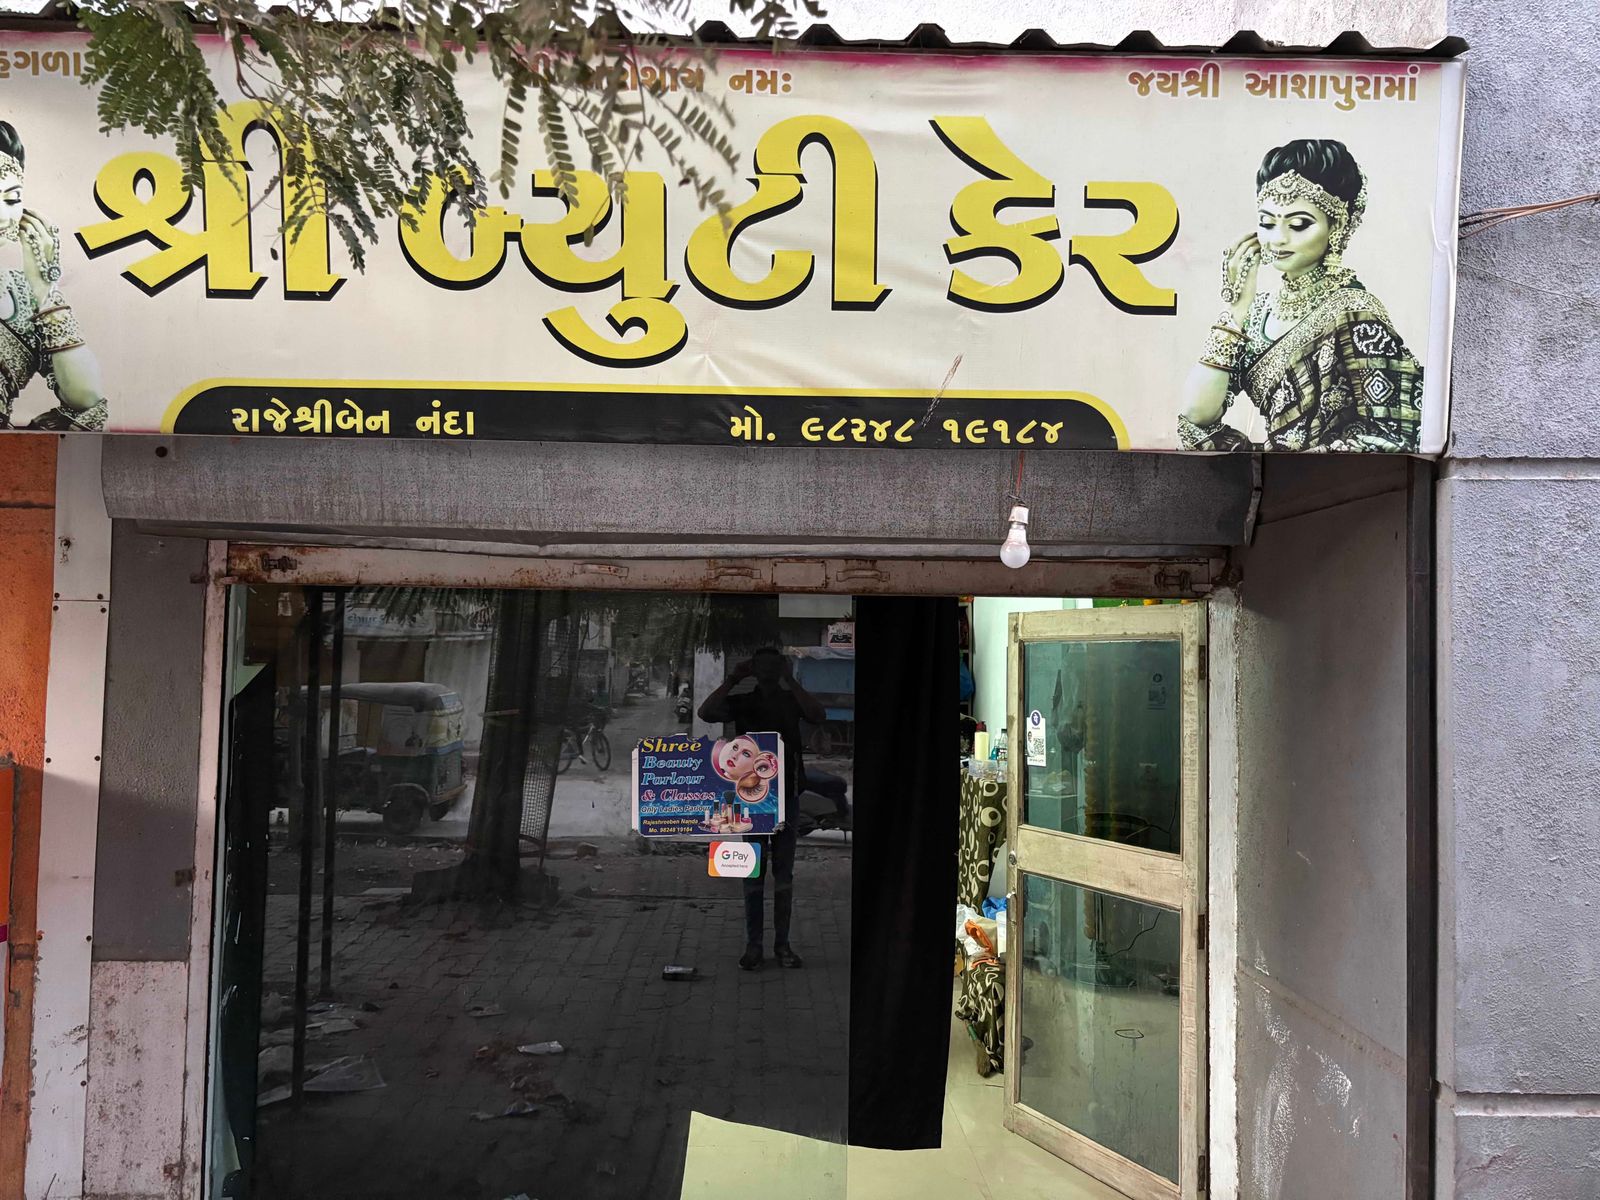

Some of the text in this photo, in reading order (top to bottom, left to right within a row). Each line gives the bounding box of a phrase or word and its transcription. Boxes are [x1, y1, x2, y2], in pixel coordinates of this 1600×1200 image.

[729, 68, 792, 95] નમઃ
[1128, 62, 1419, 111] જયશ્રી આશાપુરામાં
[74, 99, 1180, 369] શ્રી બ્યુટી કેર
[231, 397, 475, 435] રાજેશ્રીબેન નંદા
[730, 405, 1064, 445] મો. ૯૮૨૪૮ ૧૯૧૮૪
[641, 736, 702, 753] Shree
[642, 755, 703, 772] Beauty
[641, 772, 705, 786] Parlour
[641, 788, 716, 802] & Classes
[640, 805, 711, 814] Only Ladies Parlour
[721, 849, 749, 862] G Pay
